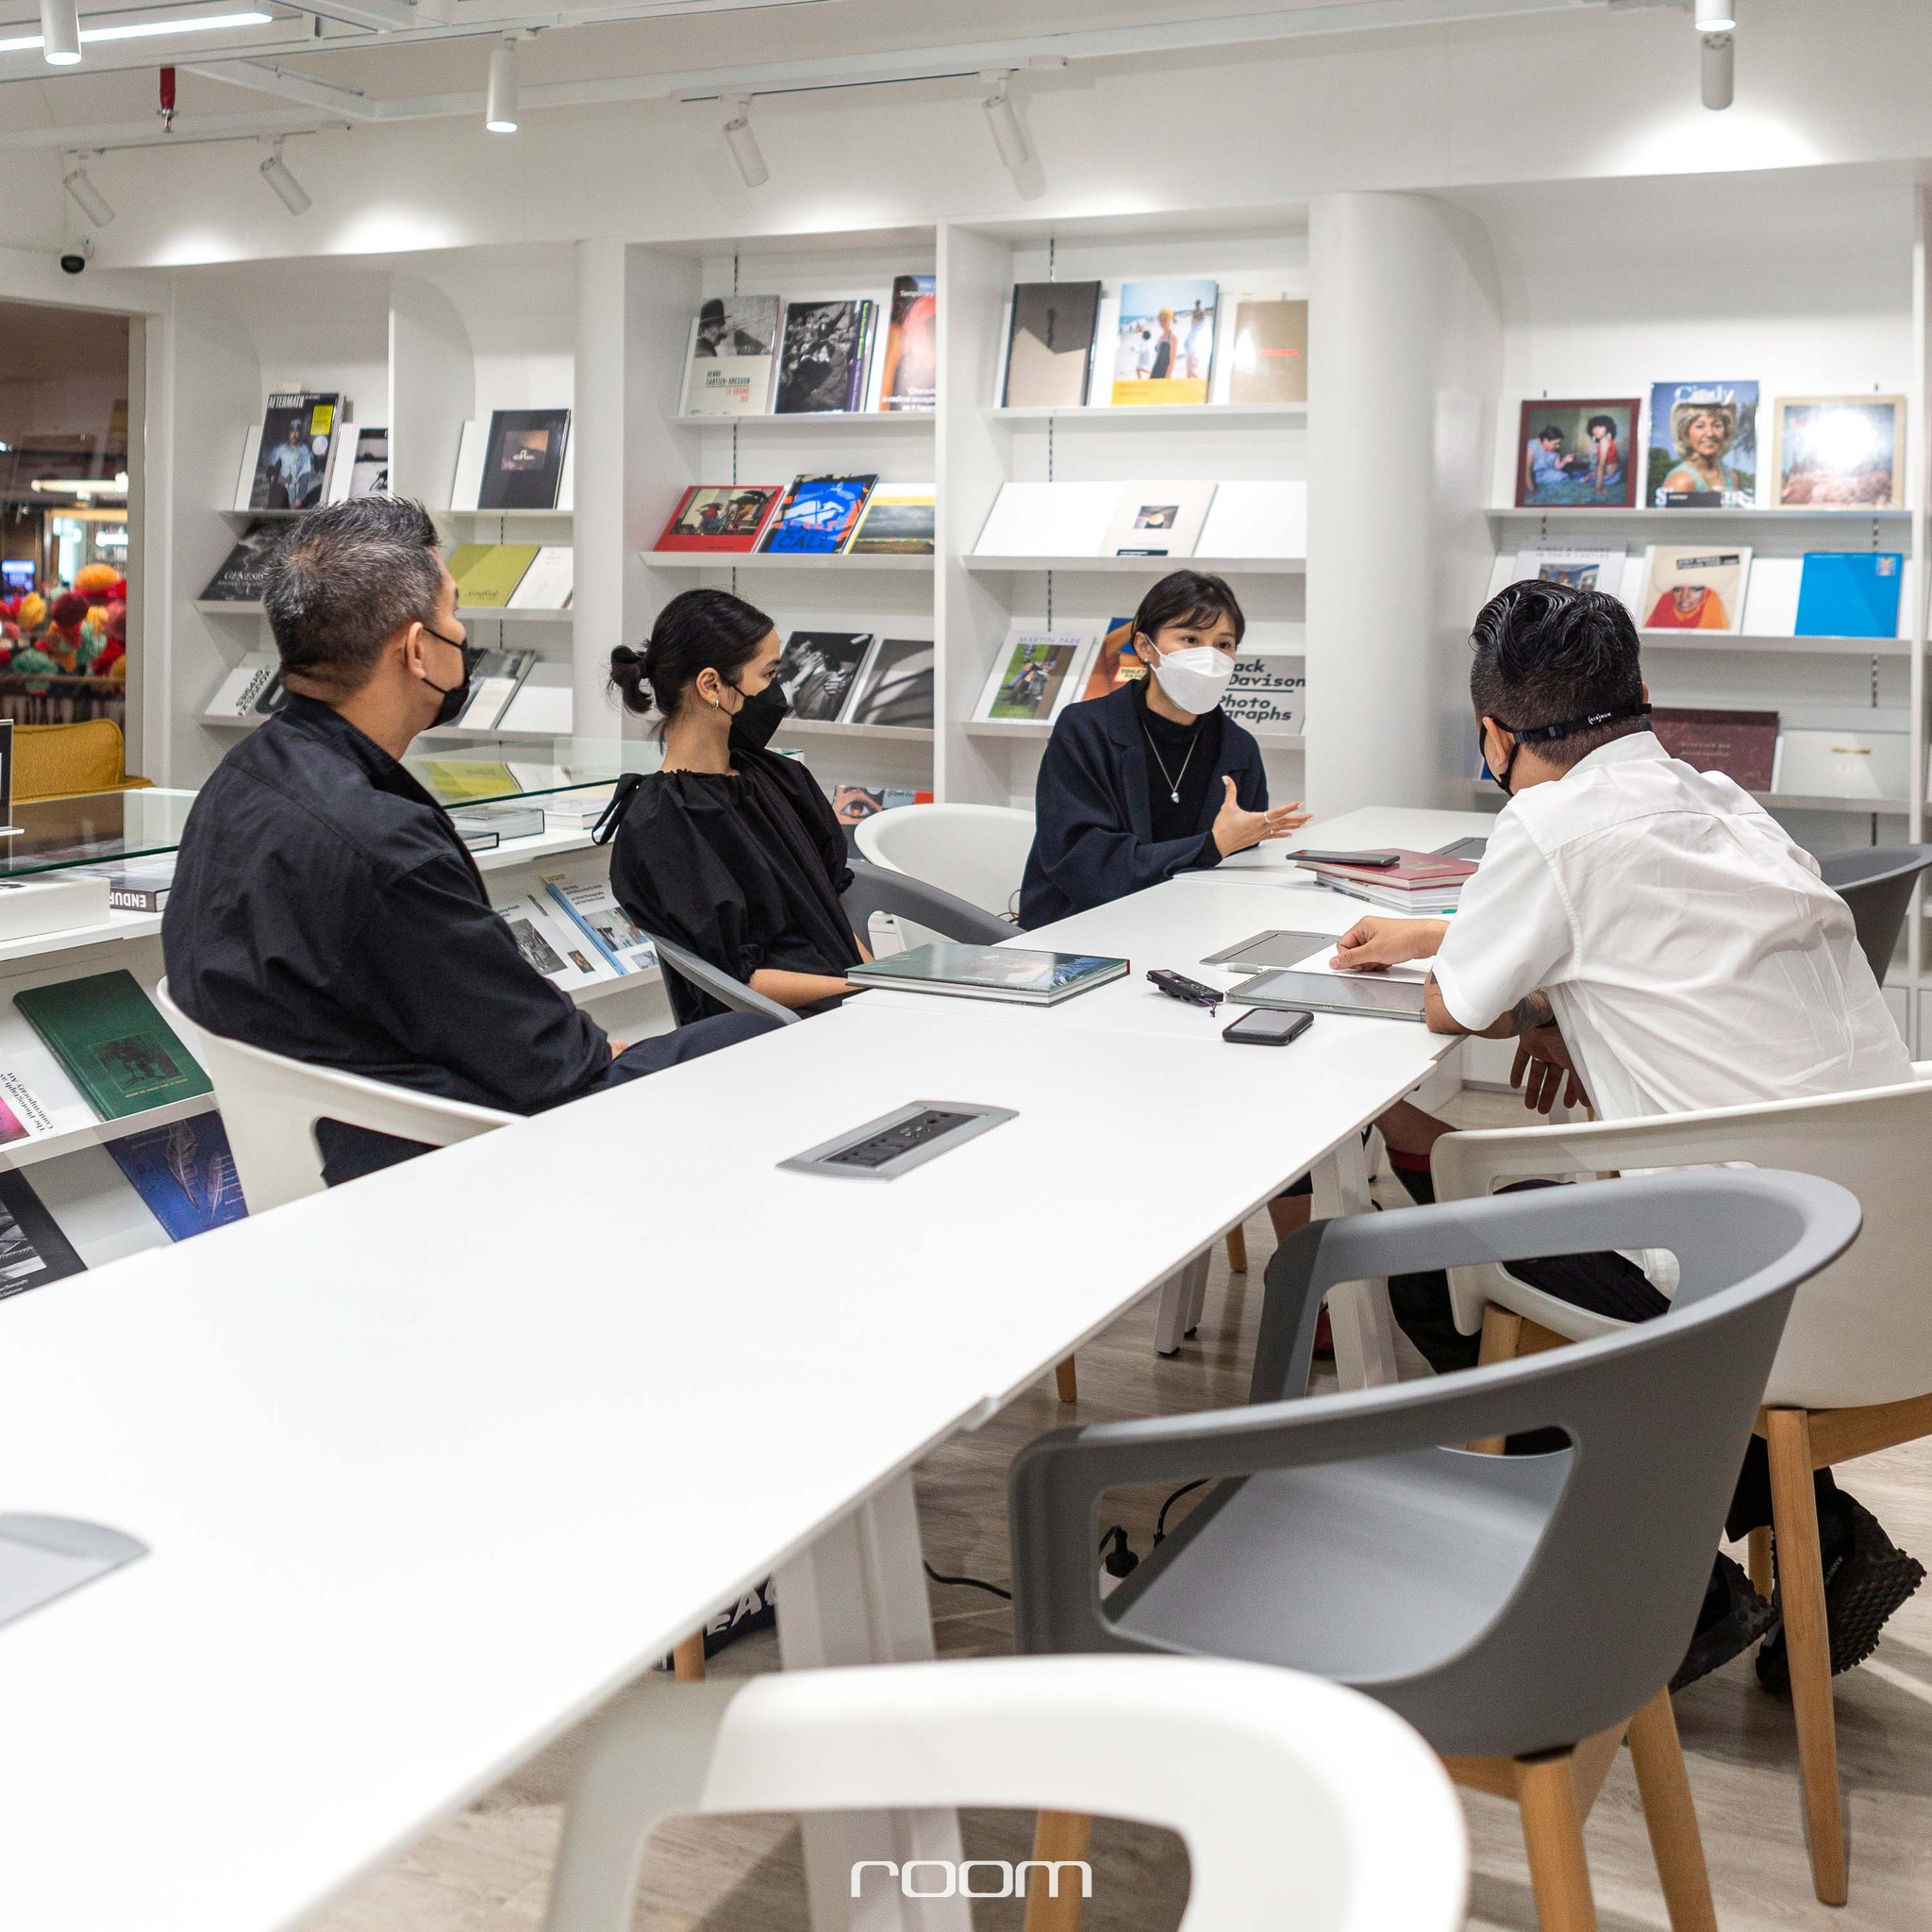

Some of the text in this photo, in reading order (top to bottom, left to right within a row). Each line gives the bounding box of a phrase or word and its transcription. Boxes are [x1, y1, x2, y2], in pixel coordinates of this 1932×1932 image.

[777, 535, 828, 549] CALL
[1018, 636, 1081, 645] MARTIN PARR
[1234, 659, 1265, 673] ack
[1228, 674, 1306, 687] Davison
[8, 1072, 19, 1083] Art
[5, 1082, 36, 1120] Photograph
[17, 1083, 54, 1130] Contemporary
